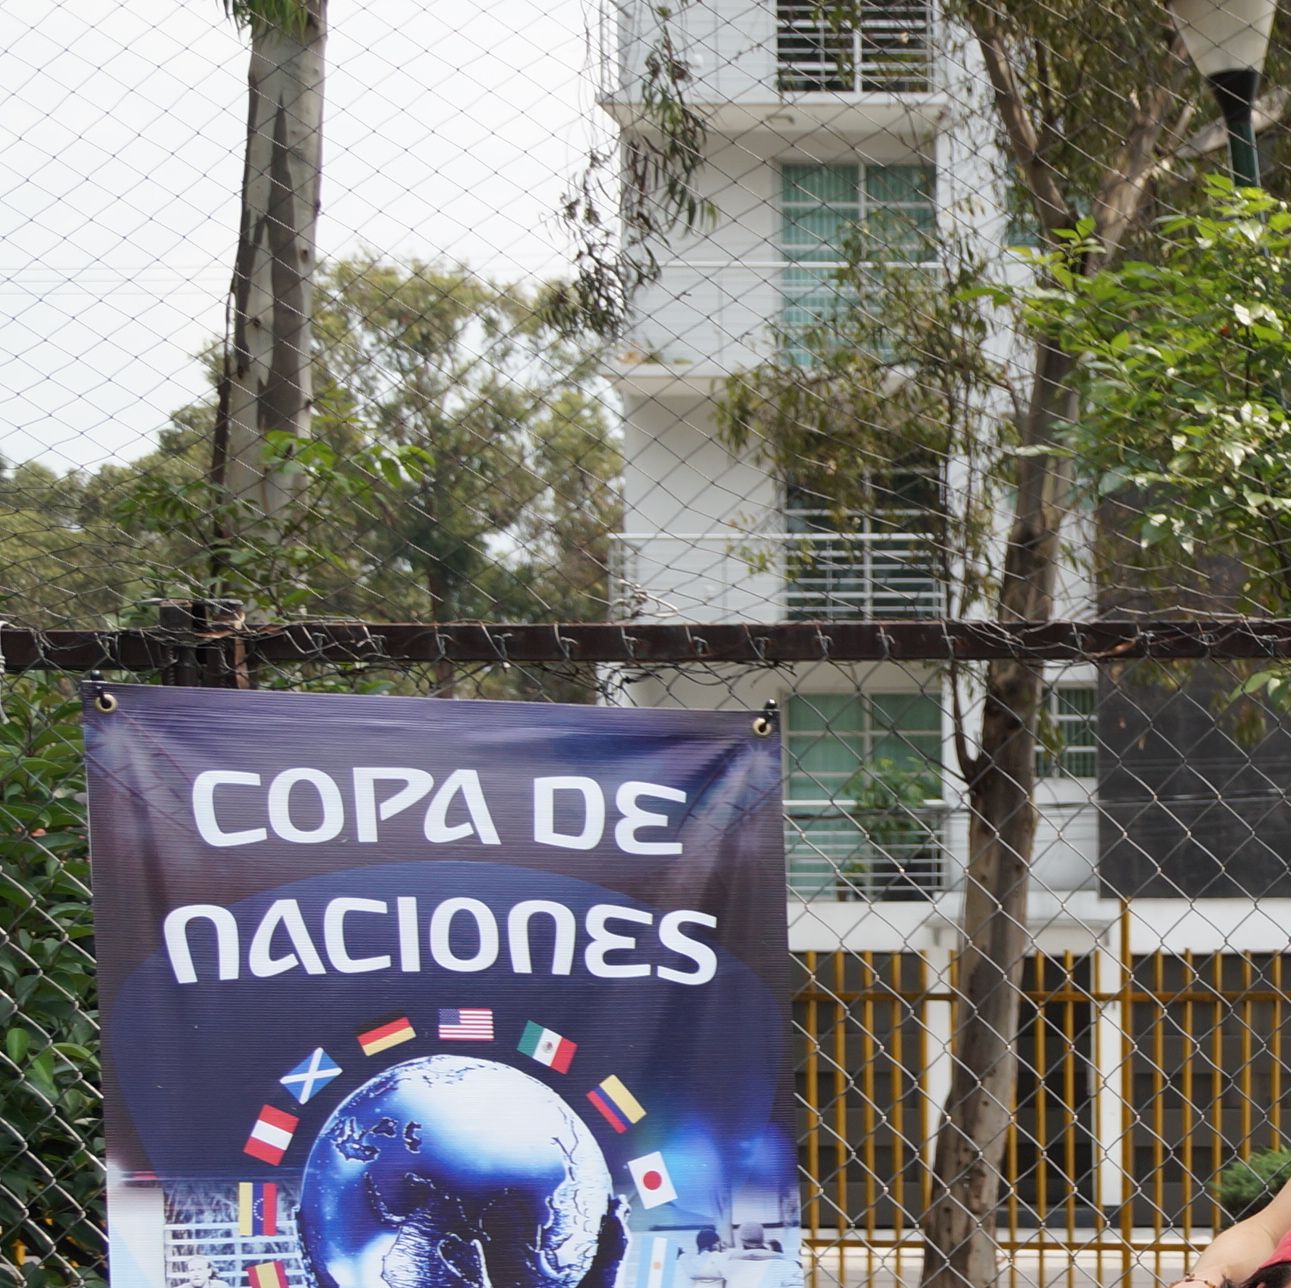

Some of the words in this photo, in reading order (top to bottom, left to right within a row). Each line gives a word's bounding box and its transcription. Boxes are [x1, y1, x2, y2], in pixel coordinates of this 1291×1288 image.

[192, 767, 501, 847] COPA
[533, 775, 687, 855] DE
[162, 896, 718, 985] NACIONES
